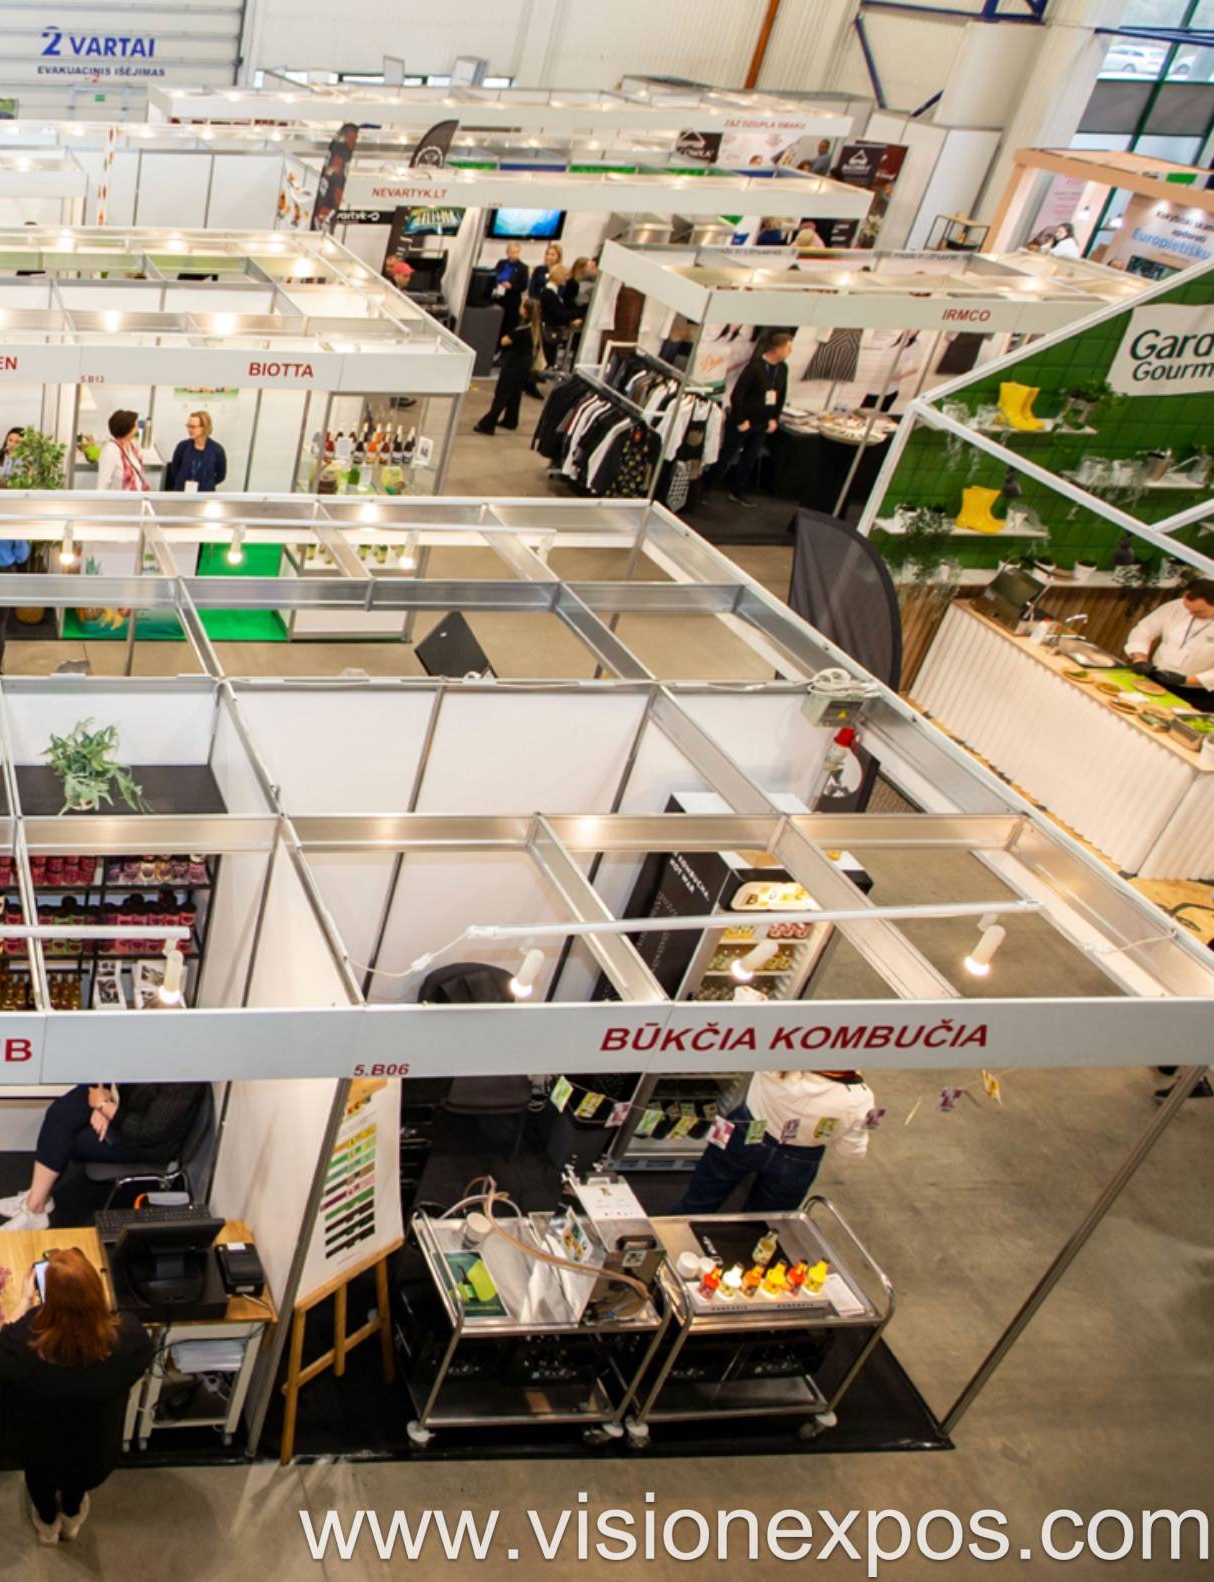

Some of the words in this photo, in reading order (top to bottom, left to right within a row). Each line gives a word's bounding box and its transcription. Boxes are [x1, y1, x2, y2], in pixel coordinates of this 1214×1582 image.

[41, 25, 63, 56] 2
[69, 36, 156, 58] VARTAI
[37, 65, 111, 76] EVAKUACINIS
[114, 66, 166, 77] IŠĖJIMAS
[371, 187, 448, 199] NEVARTYK.LT
[941, 308, 991, 323] IRMCO
[248, 362, 314, 378] BIOTTA
[599, 1020, 757, 1052] BŪKČIA
[769, 1018, 988, 1050] KOMBUČIA
[353, 1063, 410, 1076] 5.B06
